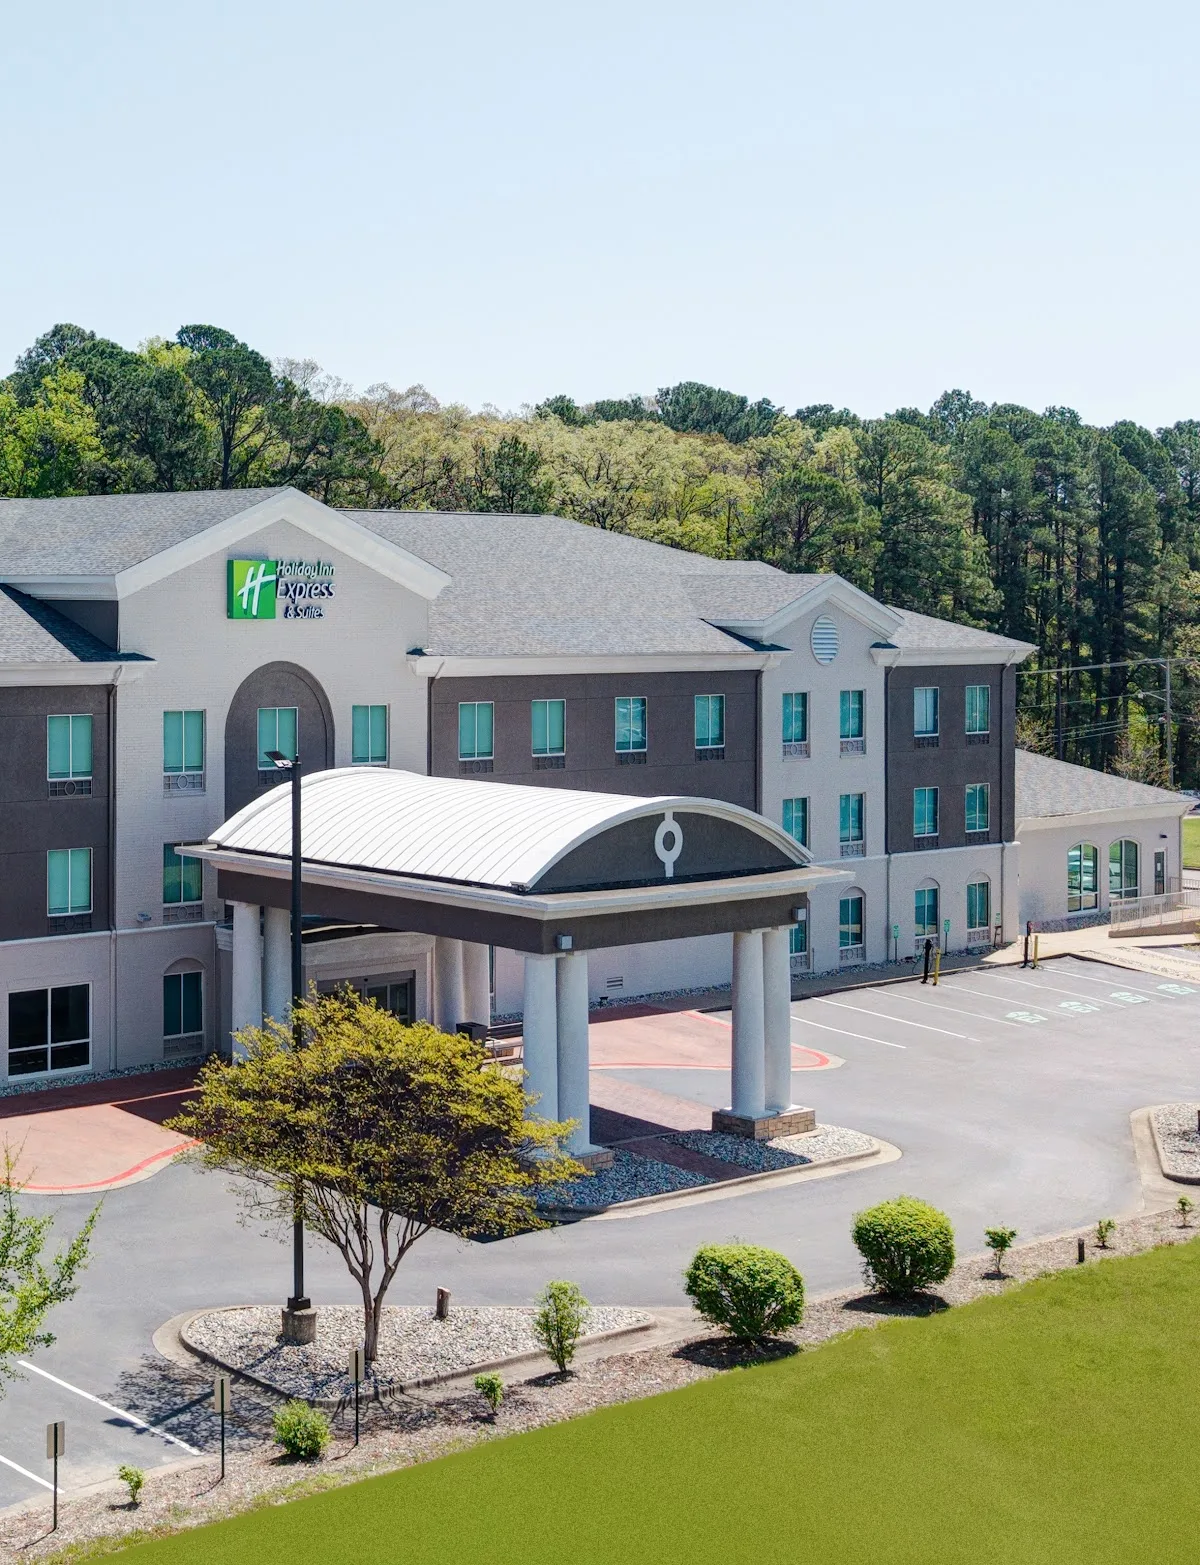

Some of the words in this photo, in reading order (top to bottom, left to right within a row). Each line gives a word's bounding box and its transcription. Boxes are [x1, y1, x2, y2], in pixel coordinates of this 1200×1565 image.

[276, 561, 318, 579] Holiday
[319, 561, 336, 576] Inn
[276, 578, 336, 604] Express
[287, 606, 295, 619] &
[296, 606, 325, 619] Suites
